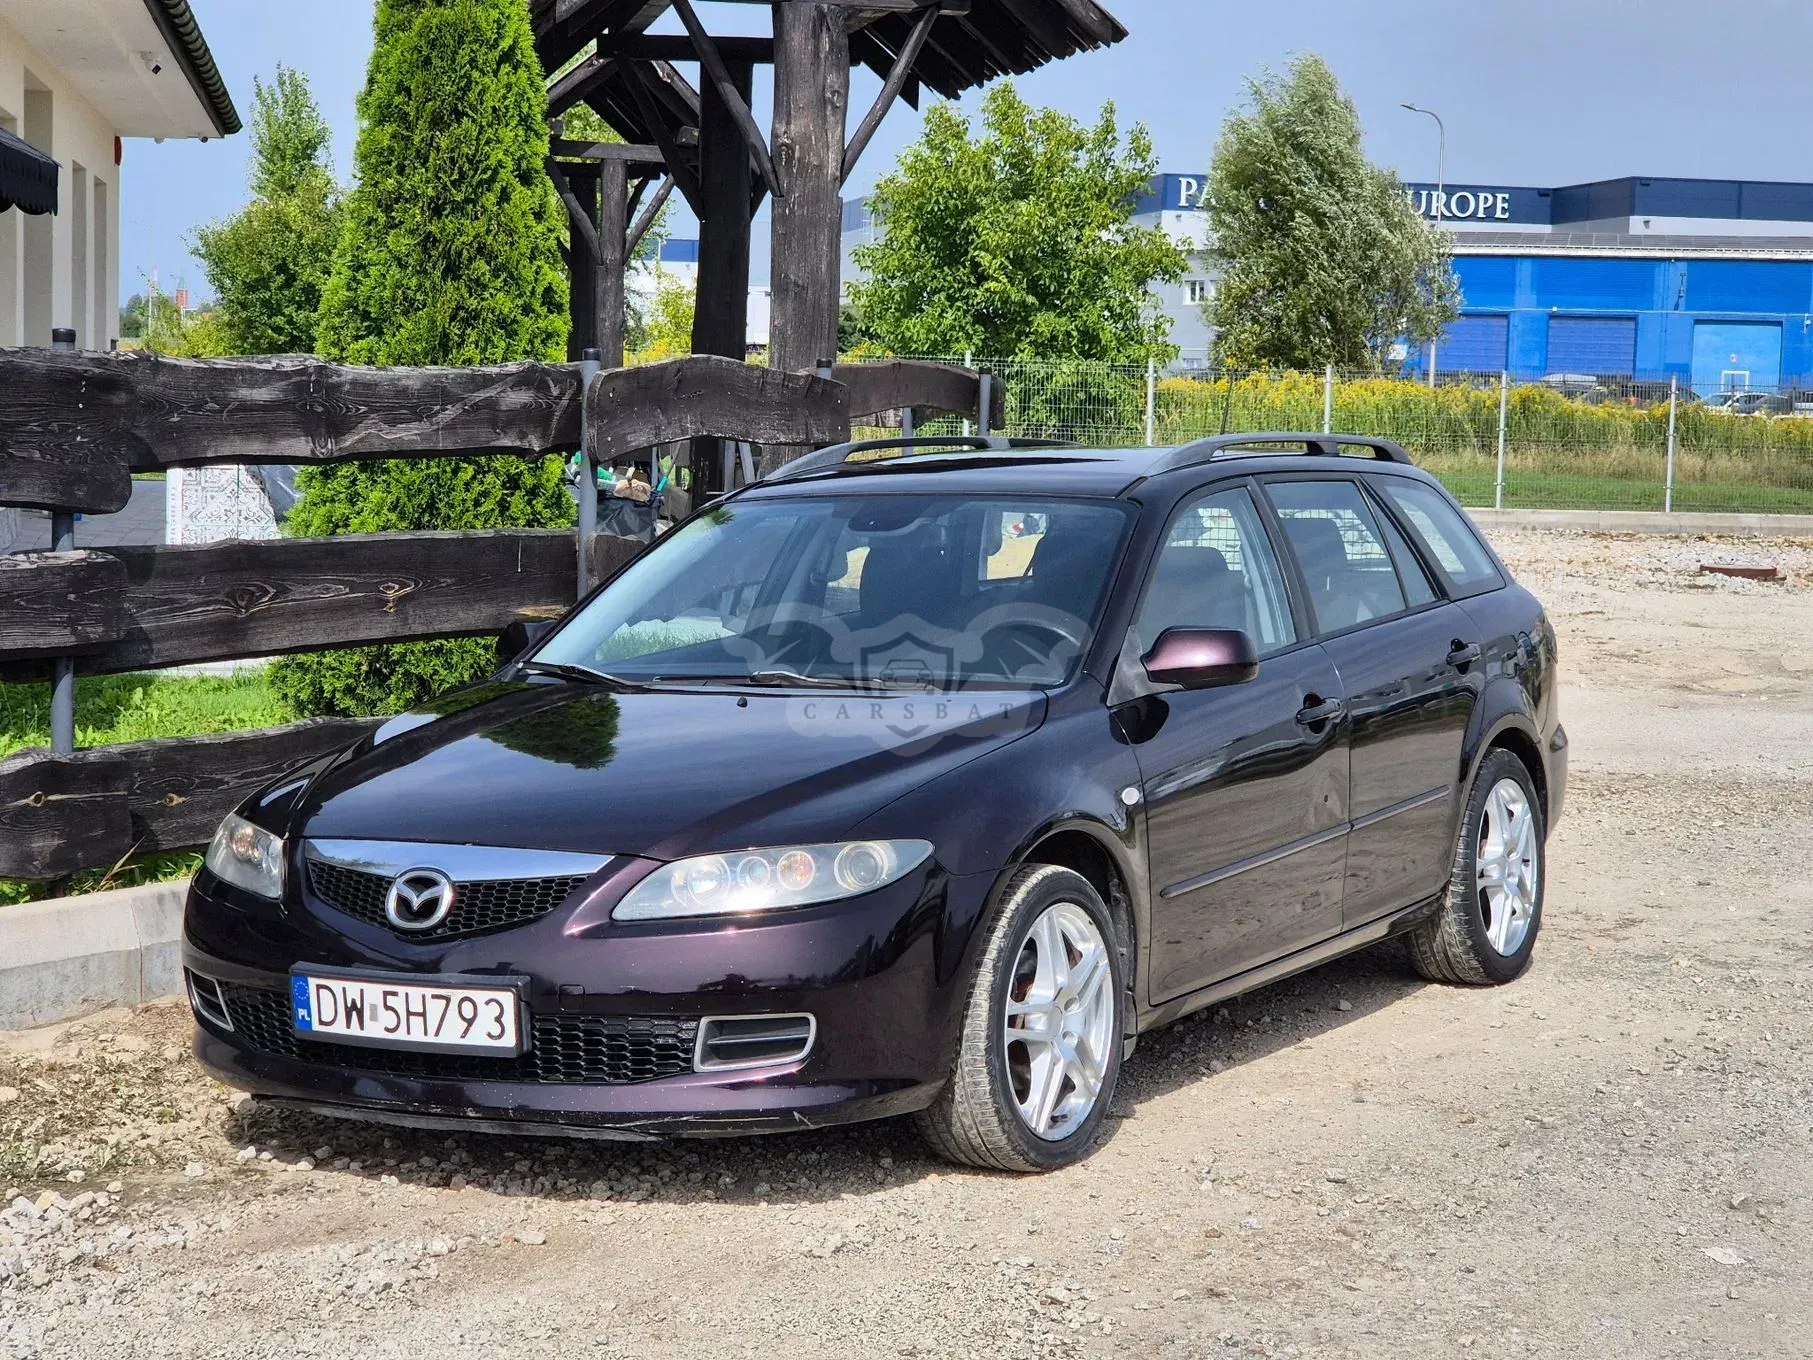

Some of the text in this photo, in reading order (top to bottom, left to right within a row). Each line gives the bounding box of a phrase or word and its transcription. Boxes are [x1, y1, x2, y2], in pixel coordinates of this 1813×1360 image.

[1399, 190, 1510, 219] UROPE
[298, 1008, 311, 1022] PL
[315, 984, 506, 1041] DW 5H793
